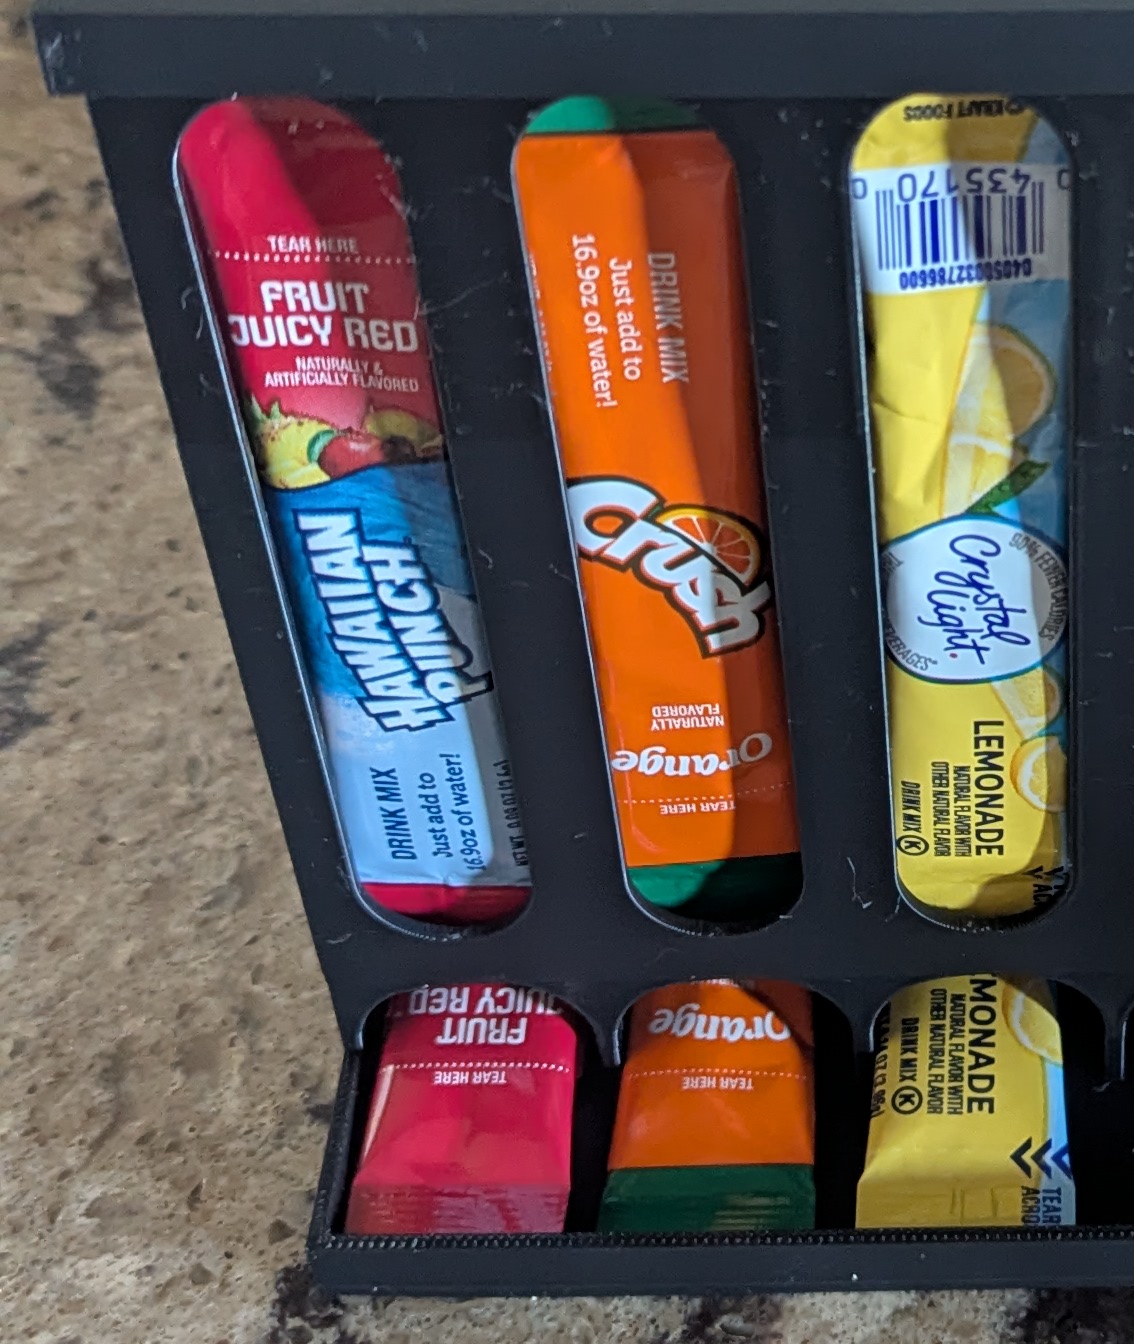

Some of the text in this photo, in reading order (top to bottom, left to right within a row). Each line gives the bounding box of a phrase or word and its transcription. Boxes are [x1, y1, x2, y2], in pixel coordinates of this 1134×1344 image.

[897, 167, 1031, 203] 435170
[266, 235, 358, 254] TEAR HERE
[260, 280, 369, 313] FRUIT
[228, 314, 418, 352] JUICY RED
[572, 233, 618, 408] 16.9oz of water!
[609, 257, 643, 381] Just add to
[647, 252, 689, 384] DRINK MIX
[264, 371, 419, 392] ARTIFICIALLY FLAVORED
[295, 356, 383, 376] NATURALLY &
[949, 533, 1031, 647] Crystal
[295, 512, 451, 731] HAWAIIAN
[362, 542, 493, 706] PUNCH
[917, 570, 987, 665] Light
[651, 716, 725, 732] NATURALLY
[652, 703, 720, 718] FLAVORED
[611, 732, 773, 776] Orange
[900, 780, 921, 812] DRINK
[954, 765, 971, 803] NATURAL
[973, 720, 1004, 856] LEMONADE
[370, 767, 417, 860] DRINK MIX
[418, 773, 454, 858] Just add to
[439, 753, 486, 871] 16.9oz of water!
[660, 800, 736, 816] TEAR HERE
[902, 813, 922, 833] MIX
[931, 761, 951, 856] OTHER NATURAL FLAVOR
[954, 805, 971, 836] FLAVOR
[409, 987, 469, 1015] RED
[435, 1017, 527, 1045] FRUIT
[900, 1017, 919, 1060] DRINK
[967, 976, 997, 1114] MONADE
[927, 988, 947, 1115] OTHER NATURAL FLAVOR
[947, 993, 966, 1115] NATURAL FLAVOR WITH
[434, 1071, 507, 1085] TEAR HERE
[682, 1076, 754, 1091] TEAR HERE
[899, 1061, 918, 1082] MIX
[1042, 1187, 1061, 1224] TEAR
